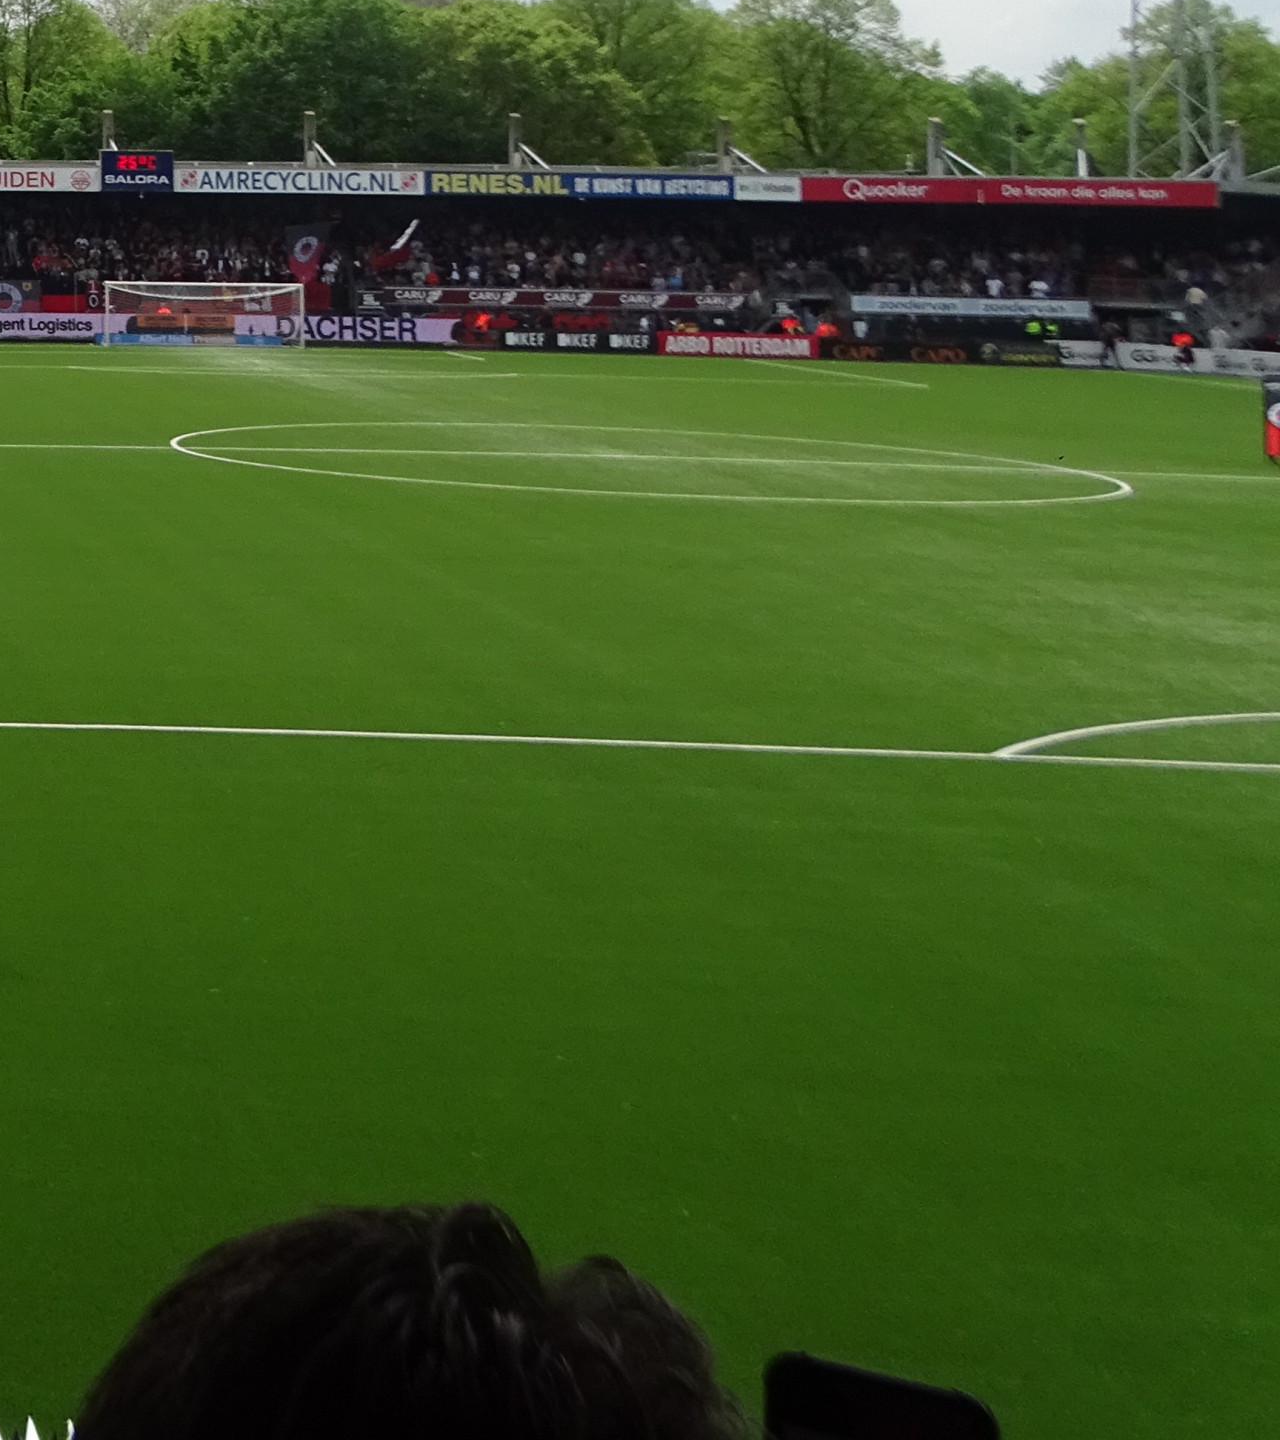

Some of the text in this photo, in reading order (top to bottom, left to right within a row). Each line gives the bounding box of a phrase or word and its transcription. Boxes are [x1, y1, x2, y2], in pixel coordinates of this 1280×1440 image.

[104, 174, 170, 185] SALORA
[199, 171, 399, 191] AMRECYCLING.NL
[431, 172, 568, 194] RENES.NL
[843, 179, 929, 200] Quooker
[29, 318, 93, 334] Logistics
[277, 316, 417, 342] DACHSER
